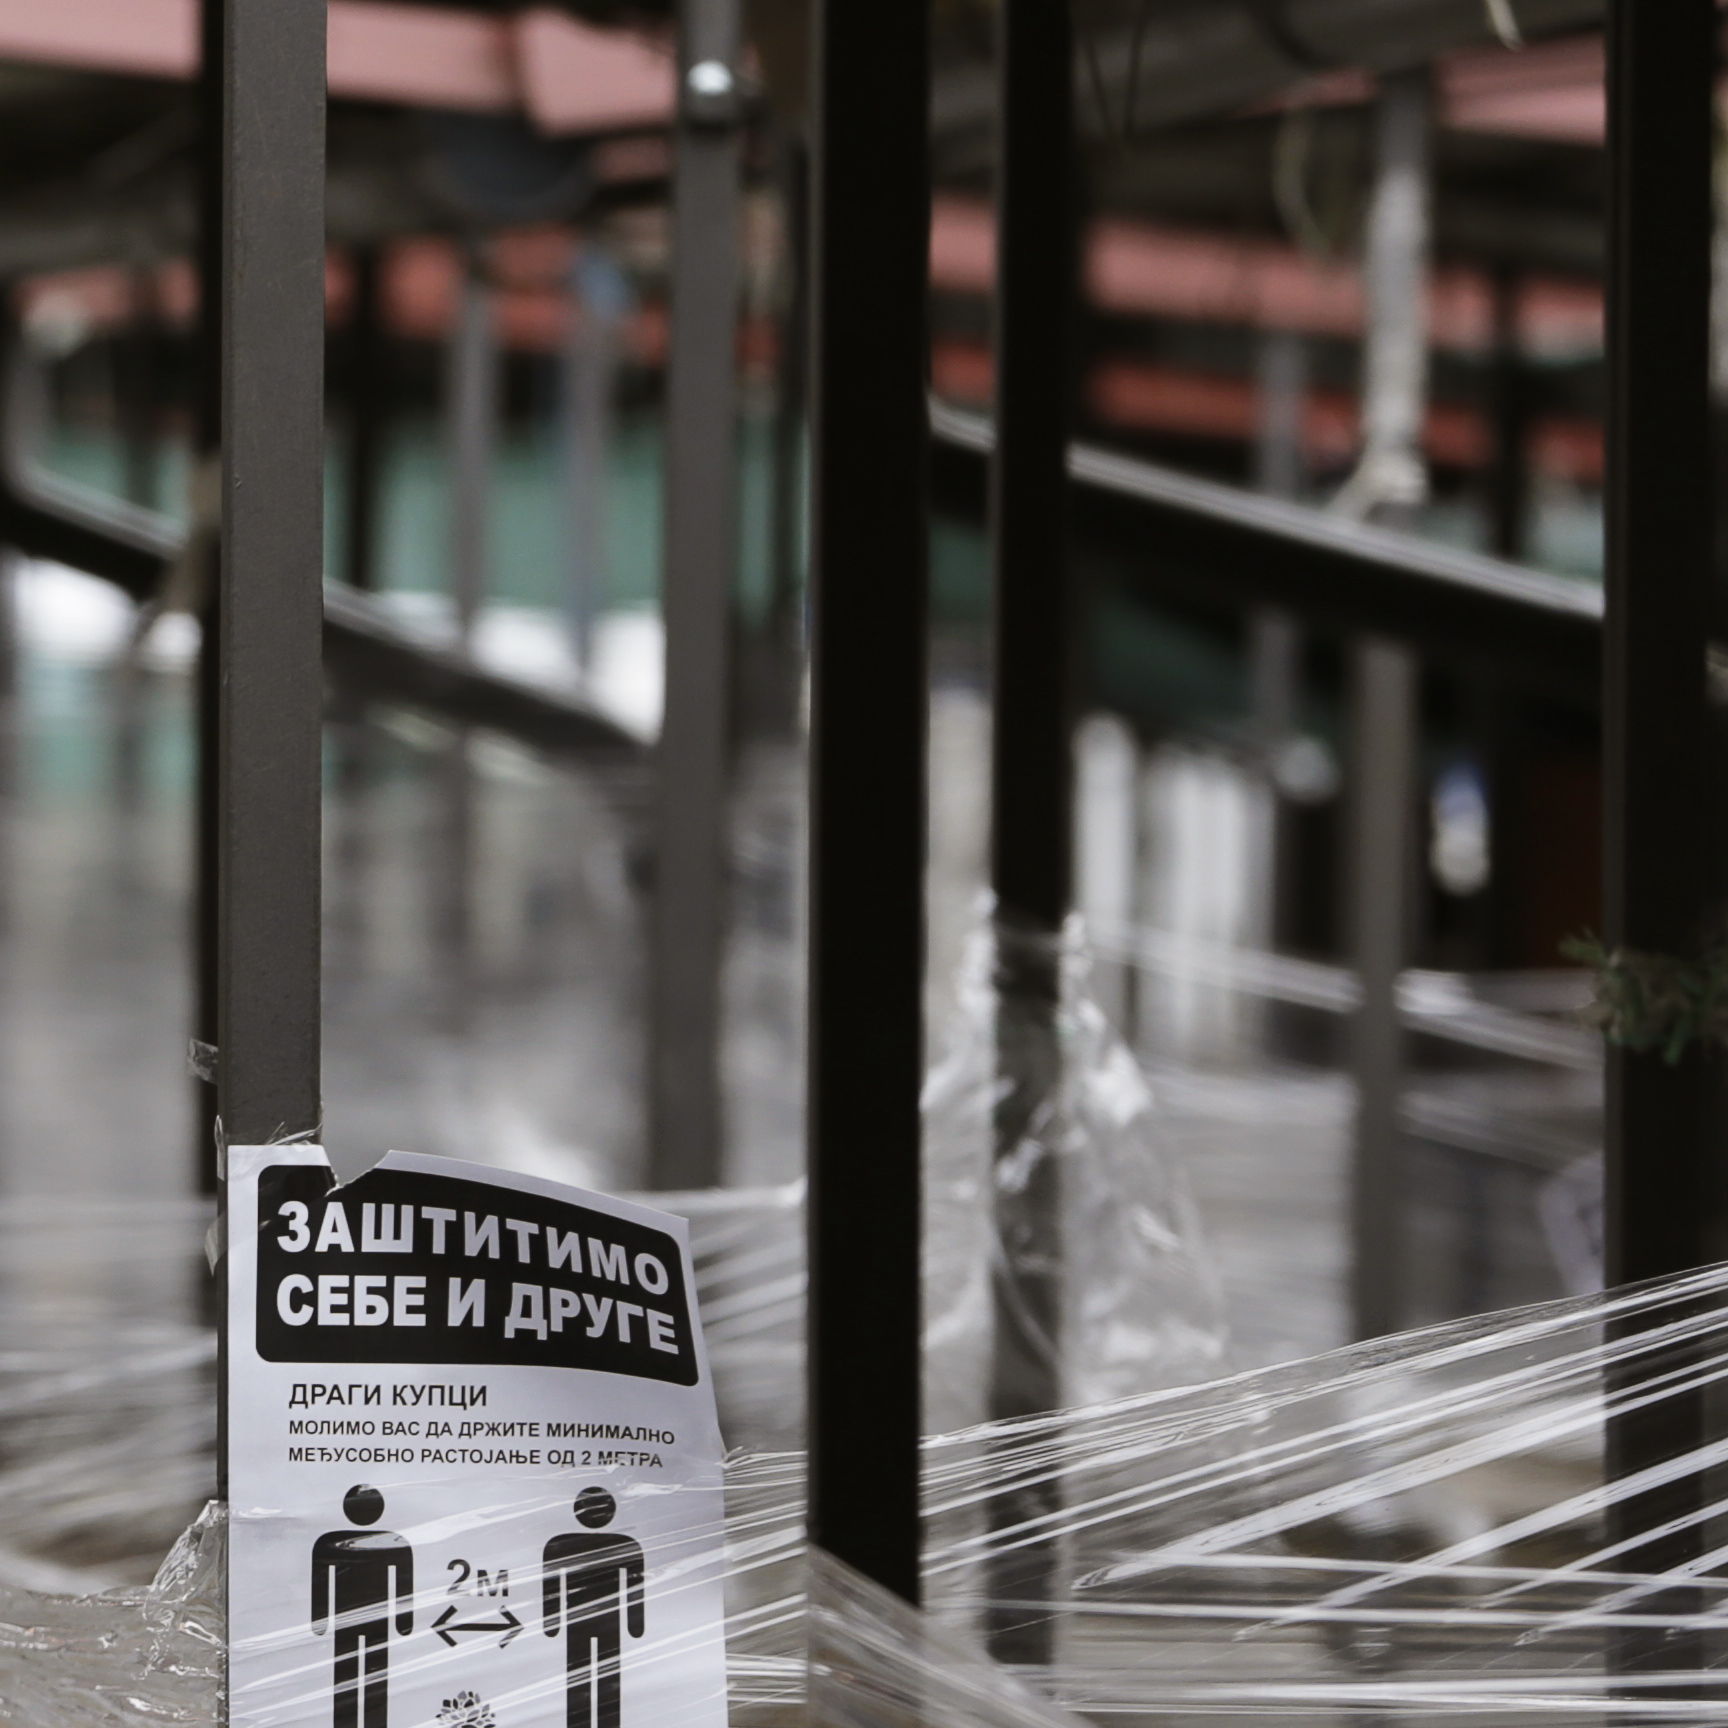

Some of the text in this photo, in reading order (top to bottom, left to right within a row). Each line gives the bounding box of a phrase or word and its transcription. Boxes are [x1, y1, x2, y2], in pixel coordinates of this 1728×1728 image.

[277, 1199, 670, 1297] ЗАШТИТИМО
[276, 1273, 680, 1356] СЕБЕ И ДРУГЕ
[288, 1382, 488, 1411] ДРАГИ КУПЦИ
[289, 1420, 676, 1446] МОЛИМО ВАС ДА ДРЖИТЕ МИНИМАЛНО
[289, 1447, 414, 1463] МЕЂУСОБНО
[420, 1449, 541, 1464] РАСТОЈАЊЕ
[547, 1450, 575, 1468] ОД
[581, 1451, 591, 1465] 2
